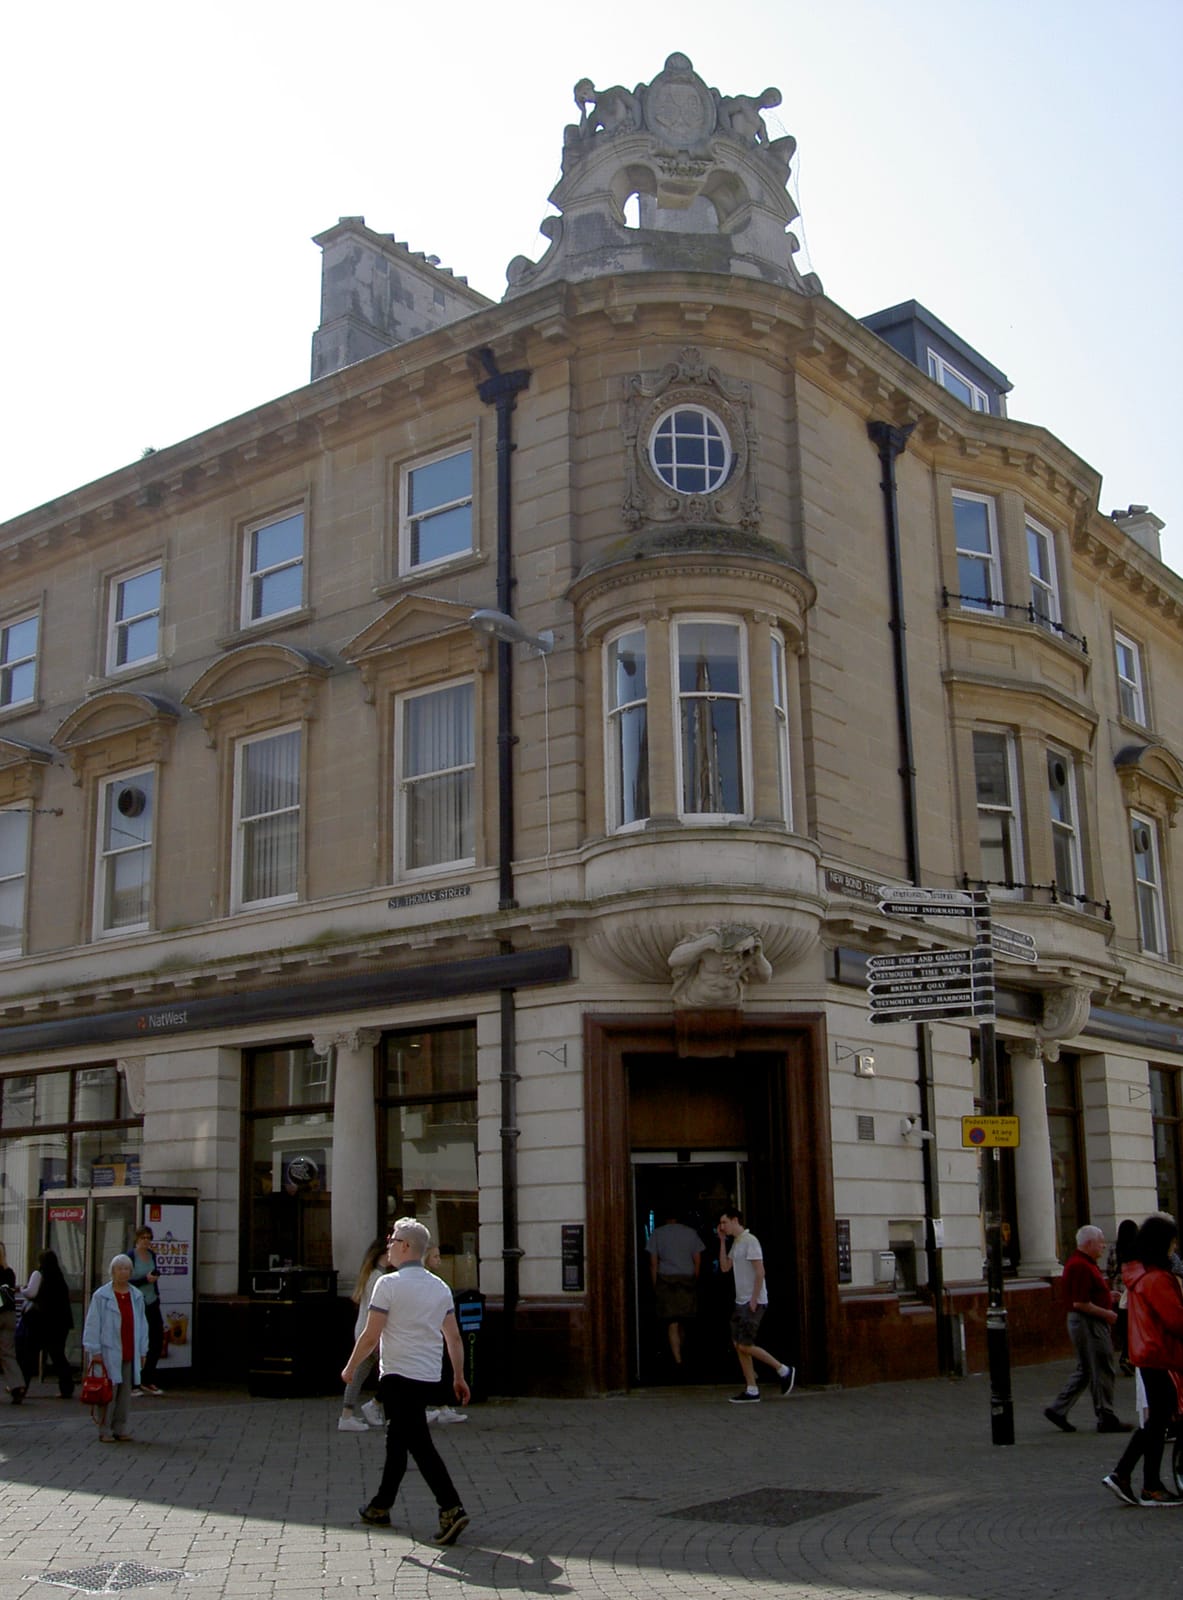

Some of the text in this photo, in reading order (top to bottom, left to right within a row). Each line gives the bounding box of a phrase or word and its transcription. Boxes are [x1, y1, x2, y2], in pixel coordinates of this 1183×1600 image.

[830, 871, 844, 884] NEW
[845, 876, 862, 890] BOND
[864, 882, 880, 896] STRE
[405, 890, 437, 905] THOMAS
[439, 885, 468, 899] STREET
[891, 905, 966, 915] TOURIST INFORMATION
[898, 956, 915, 964] FORT
[935, 952, 967, 961] GARDENS
[875, 970, 914, 979] WEYMOUTH
[941, 966, 962, 974] WALK
[926, 982, 947, 990] QUAY
[876, 993, 971, 1008] WEYMOUTH OLD HARBOUR
[148, 1010, 188, 1028] NatWest
[157, 1256, 188, 1265] OVER
